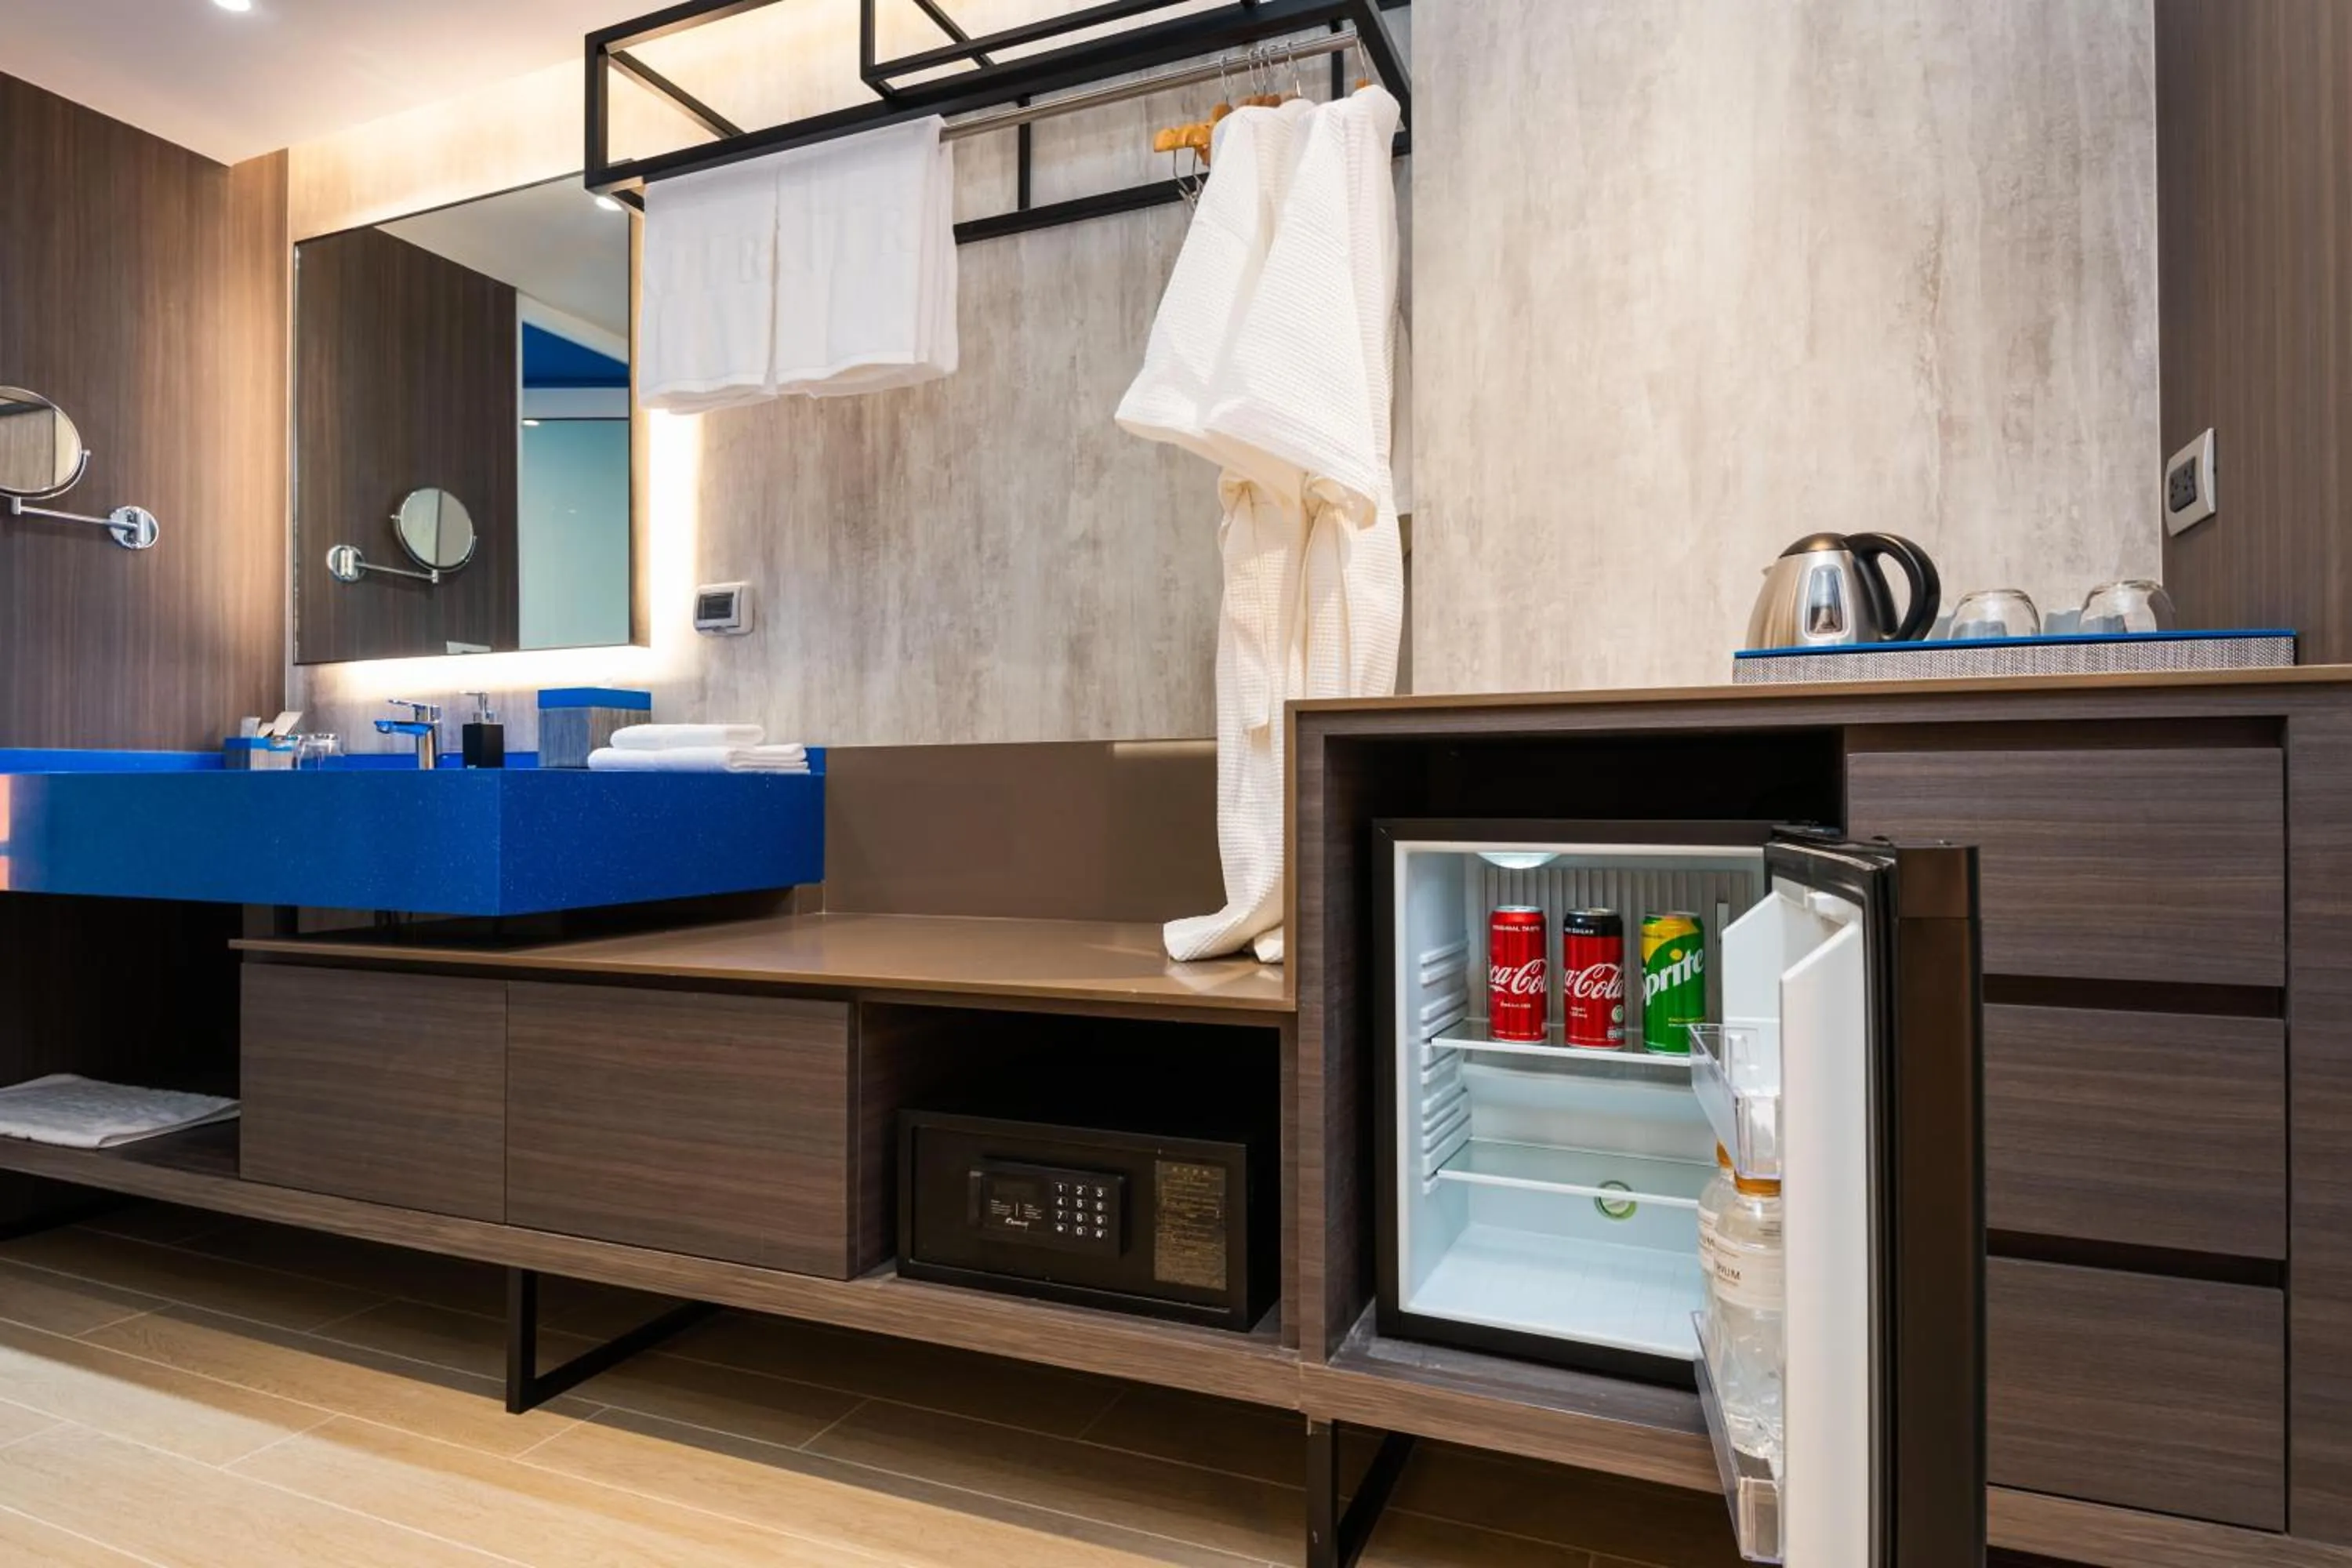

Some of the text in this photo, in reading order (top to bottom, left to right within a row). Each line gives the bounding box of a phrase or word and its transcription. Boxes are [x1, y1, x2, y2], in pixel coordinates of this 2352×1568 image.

[1642, 949, 1704, 1007] prite
[1076, 1185, 1083, 1196] 2
[1076, 1213, 1083, 1222] 8
